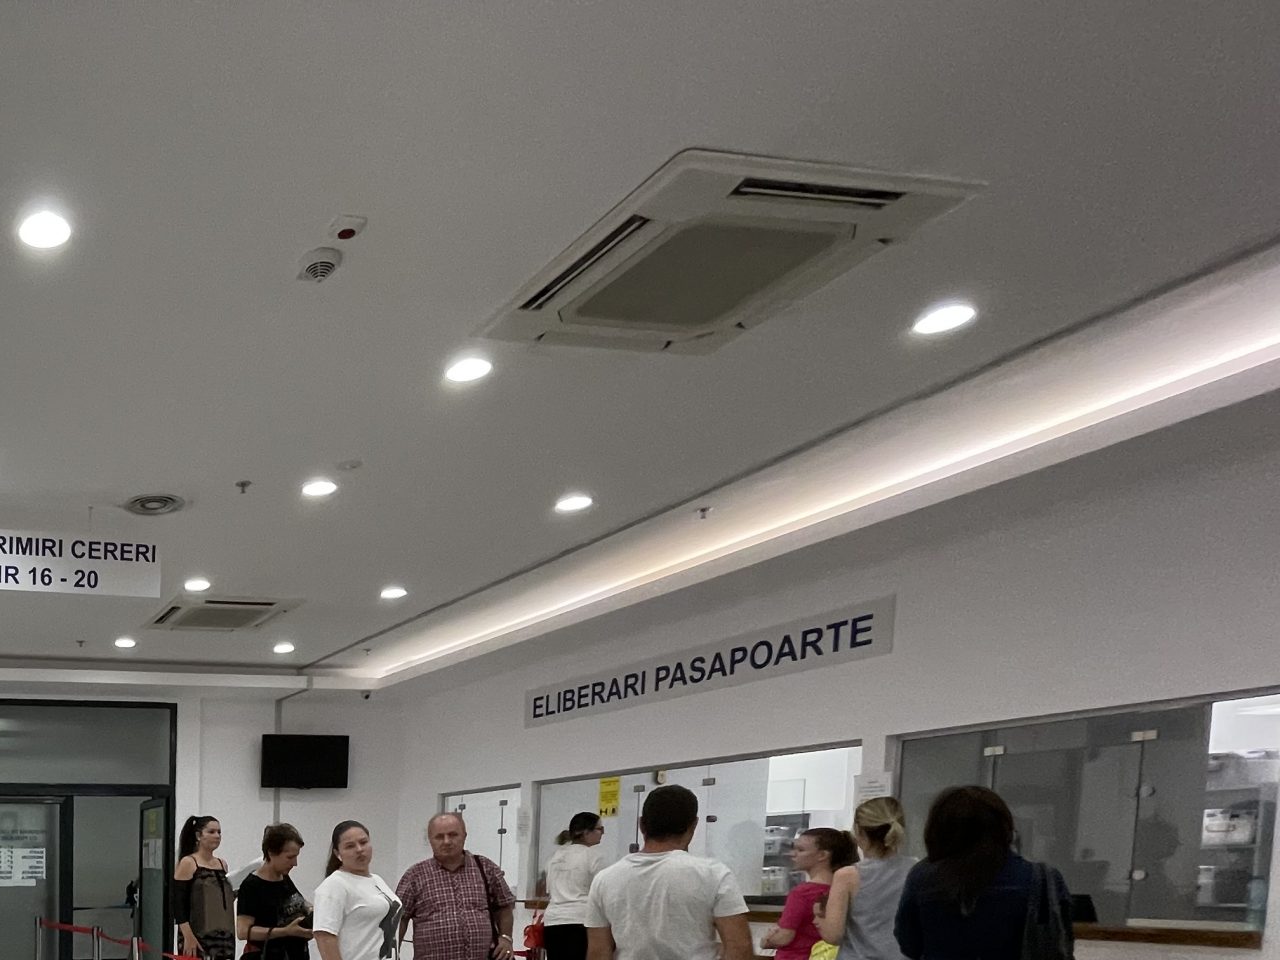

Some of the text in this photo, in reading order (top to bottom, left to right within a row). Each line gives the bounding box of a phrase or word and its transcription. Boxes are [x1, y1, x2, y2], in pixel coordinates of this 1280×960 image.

[71, 540, 156, 563] CERERI
[28, 567, 52, 586] 16
[74, 569, 99, 589] 20
[532, 614, 874, 719] ELIBERARI PASAPOARTE
